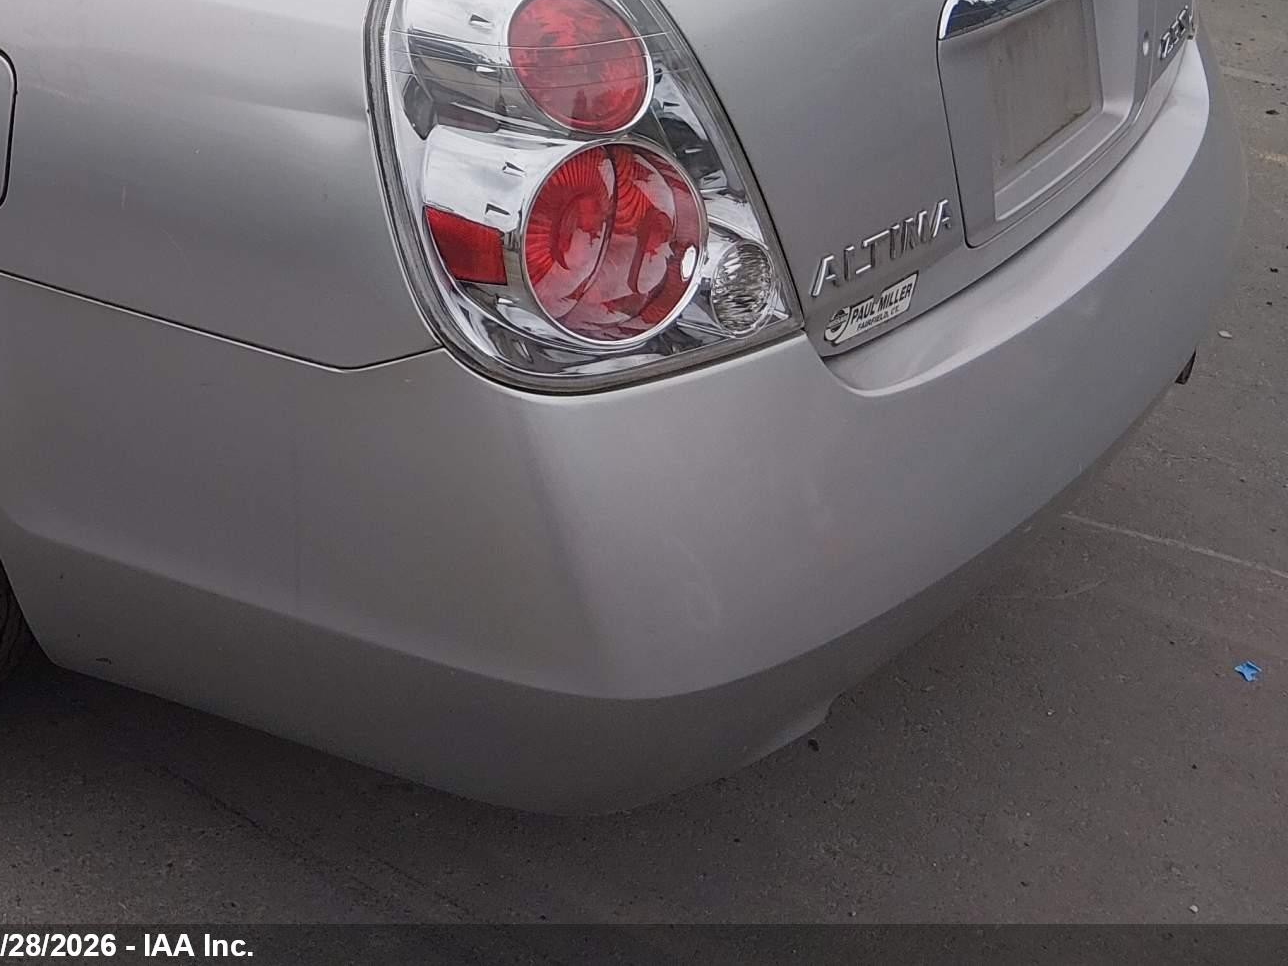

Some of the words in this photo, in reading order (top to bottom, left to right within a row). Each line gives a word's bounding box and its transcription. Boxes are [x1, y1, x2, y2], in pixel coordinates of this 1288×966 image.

[810, 199, 952, 296] ALTIMA
[850, 300, 876, 324] PAUL
[877, 282, 913, 313] MILLER
